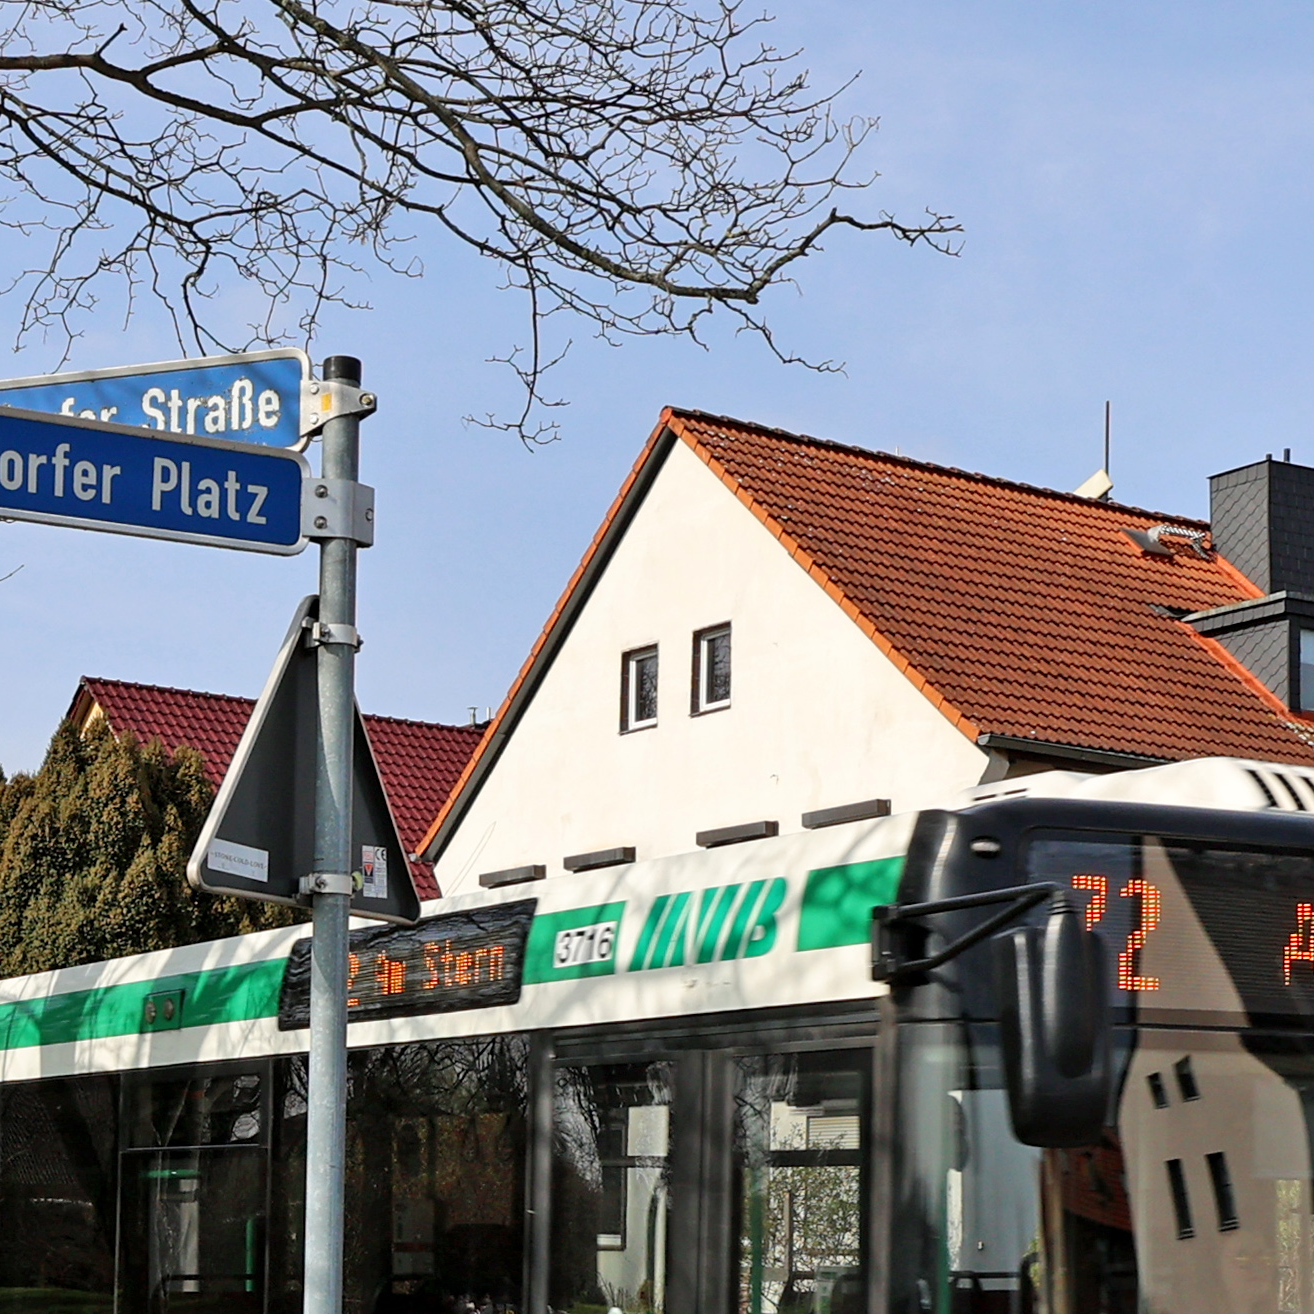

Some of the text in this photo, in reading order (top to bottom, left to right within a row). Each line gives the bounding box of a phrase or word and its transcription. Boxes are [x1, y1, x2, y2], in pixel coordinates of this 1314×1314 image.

[141, 376, 281, 434] Straße
[151, 456, 268, 525] Platz
[422, 939, 505, 989] Stern
[557, 926, 614, 964] 3716
